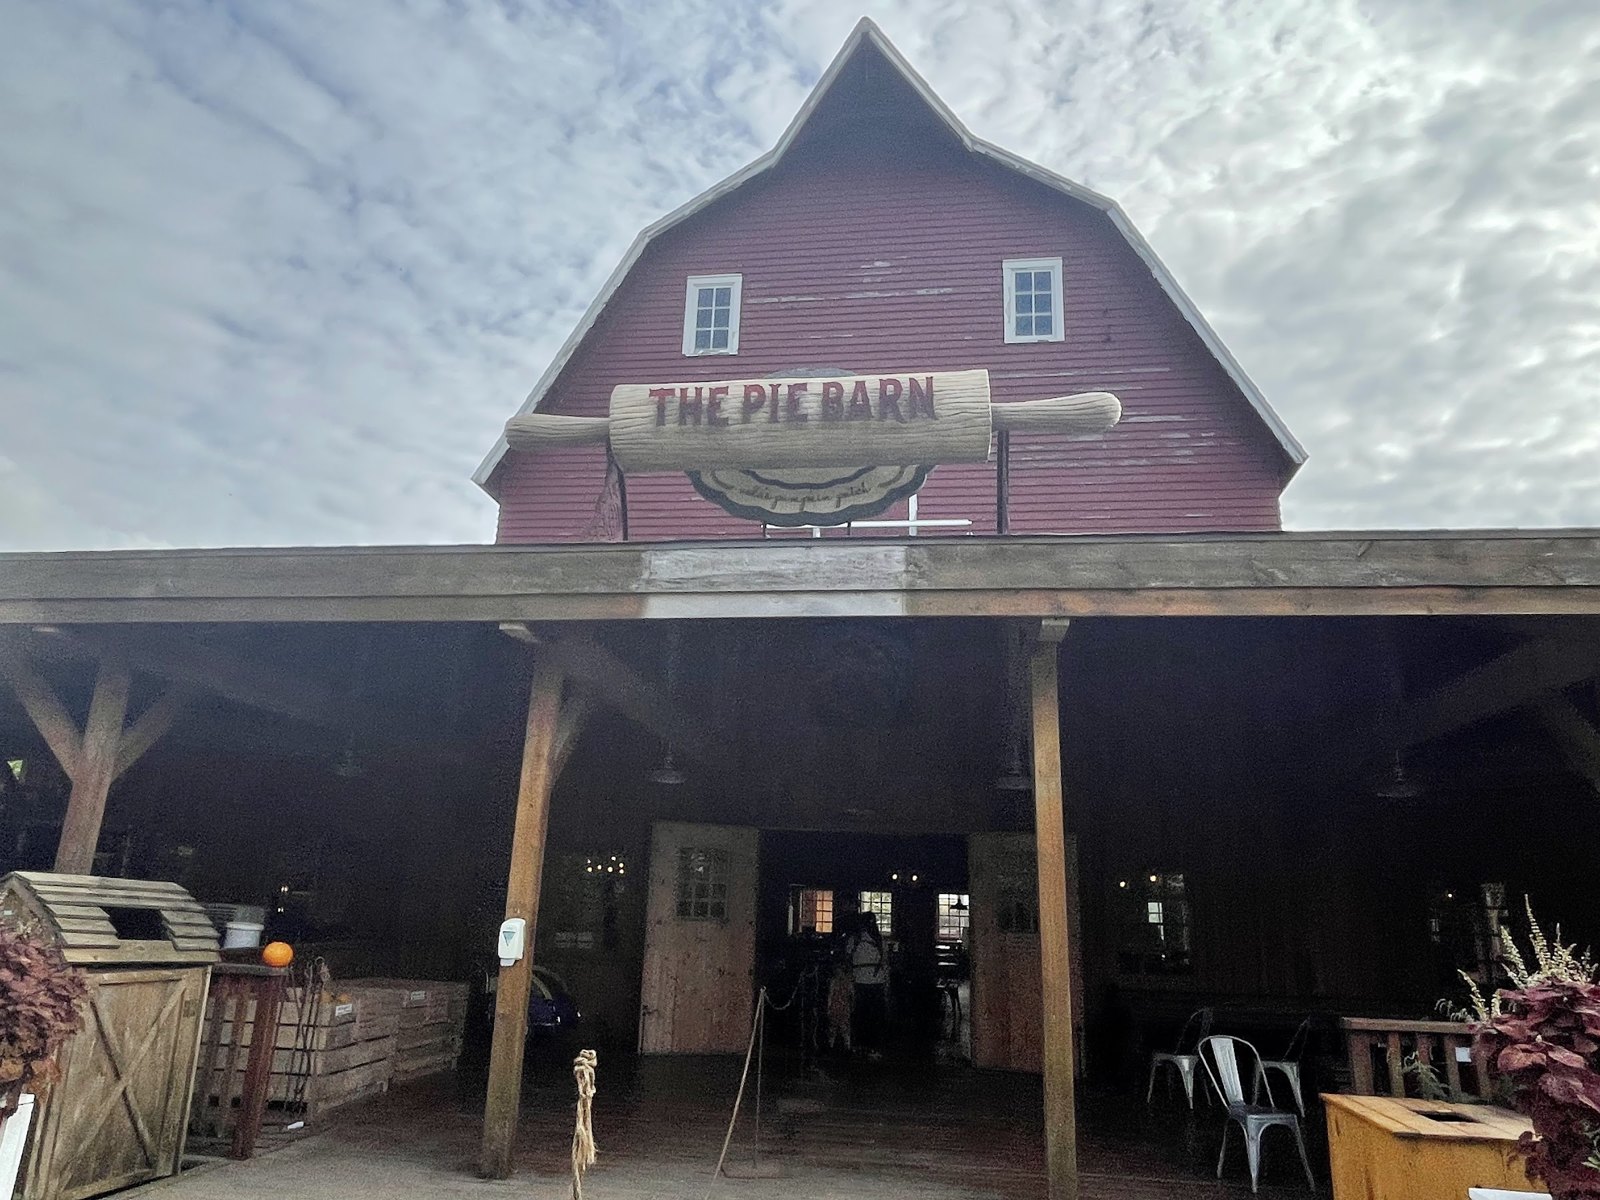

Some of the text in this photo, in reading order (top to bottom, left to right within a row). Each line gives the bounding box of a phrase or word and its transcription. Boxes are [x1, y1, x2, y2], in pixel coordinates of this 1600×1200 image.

[648, 376, 938, 427] THE PIE BARN
